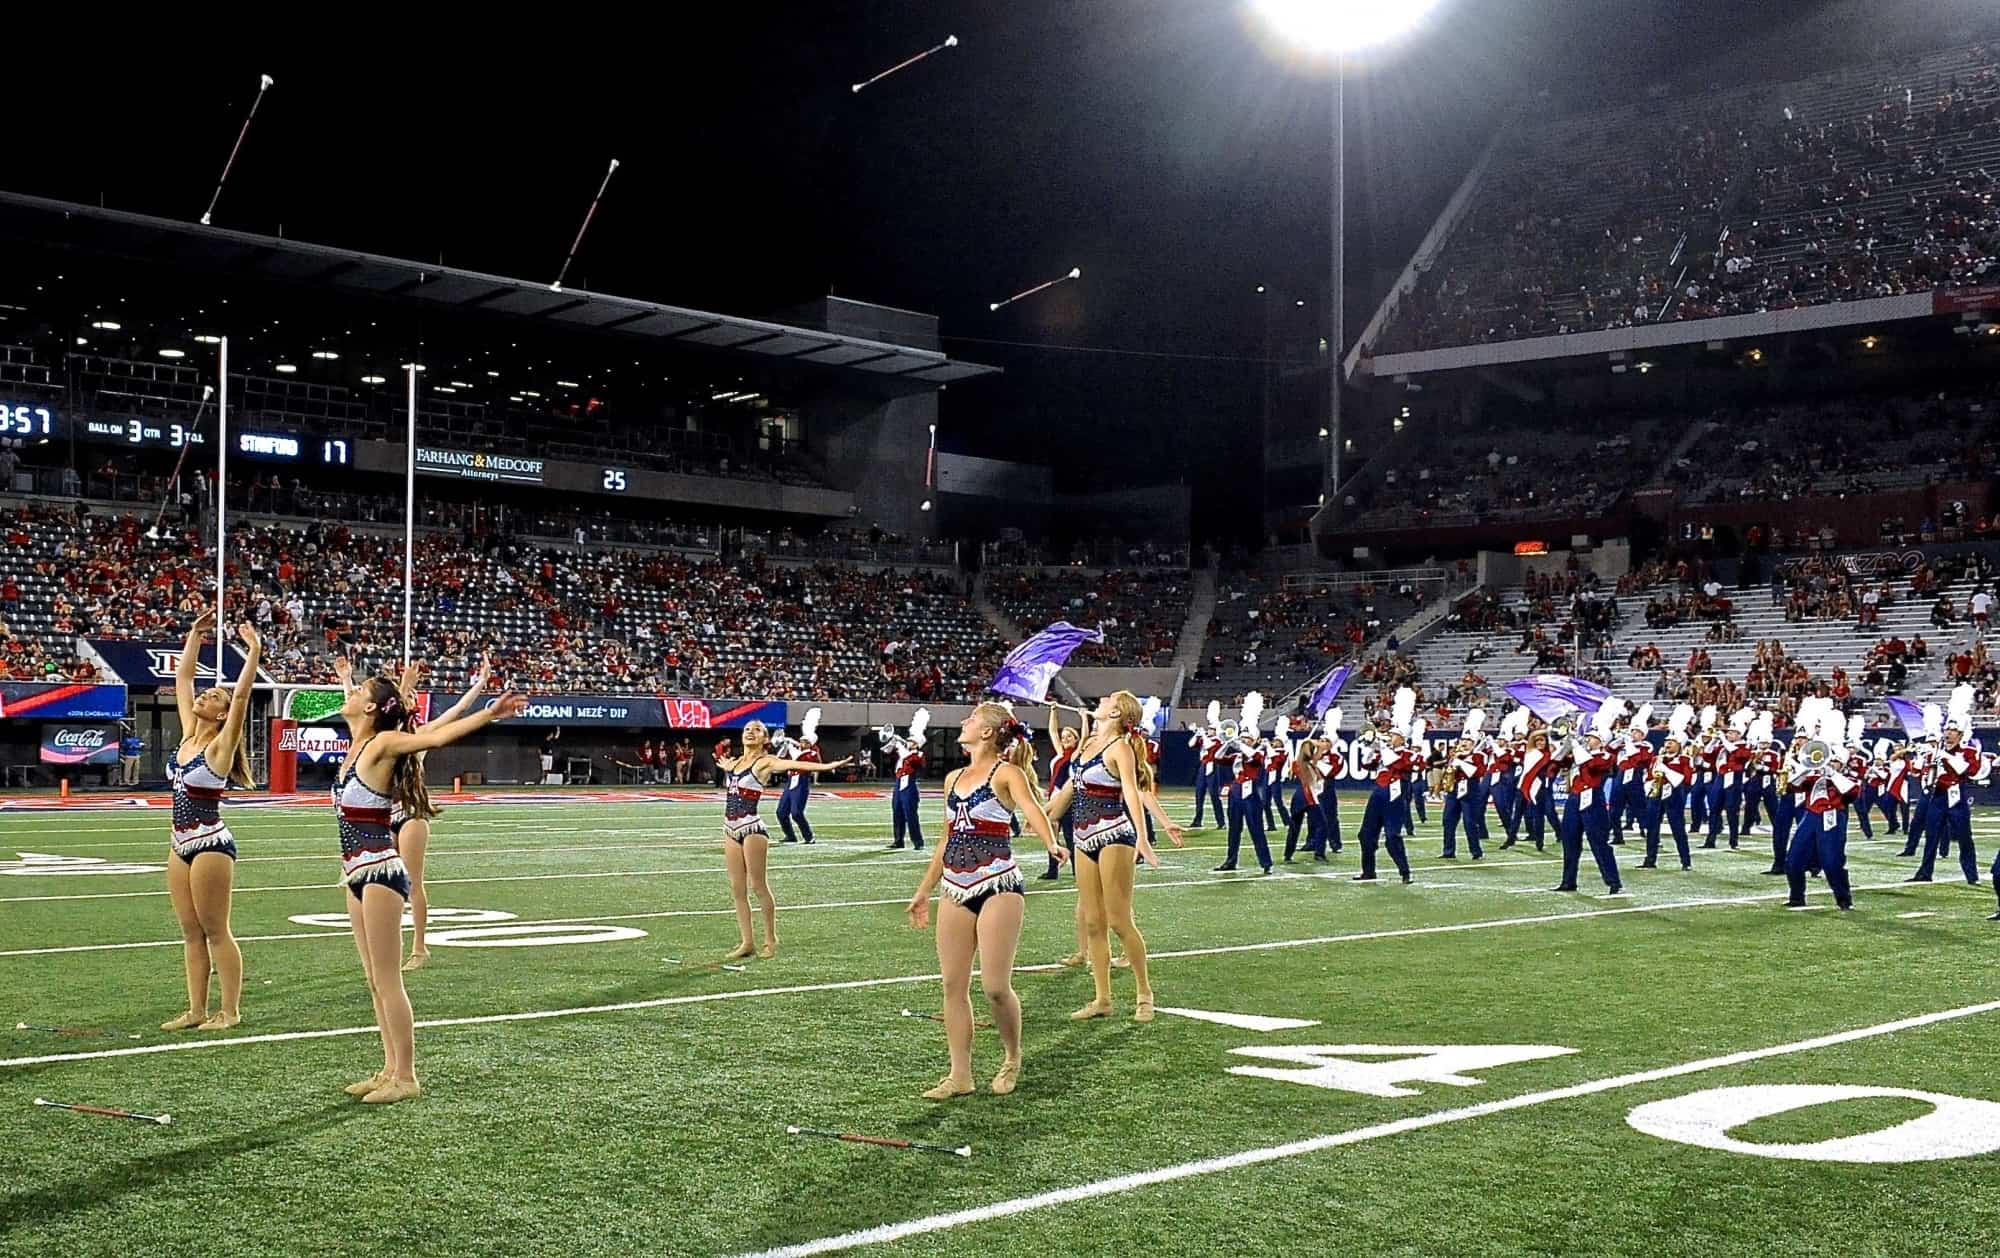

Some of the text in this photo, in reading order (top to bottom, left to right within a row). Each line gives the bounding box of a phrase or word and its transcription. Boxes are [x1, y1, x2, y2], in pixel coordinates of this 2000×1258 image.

[88, 422, 109, 433] BALL
[110, 424, 123, 435] ON
[129, 420, 141, 442] 3
[170, 424, 183, 446] 3
[325, 441, 346, 463] 17
[461, 468, 499, 480] Attorneys
[603, 470, 625, 490] 25
[610, 708, 628, 718] DIP
[953, 801, 976, 832] A
